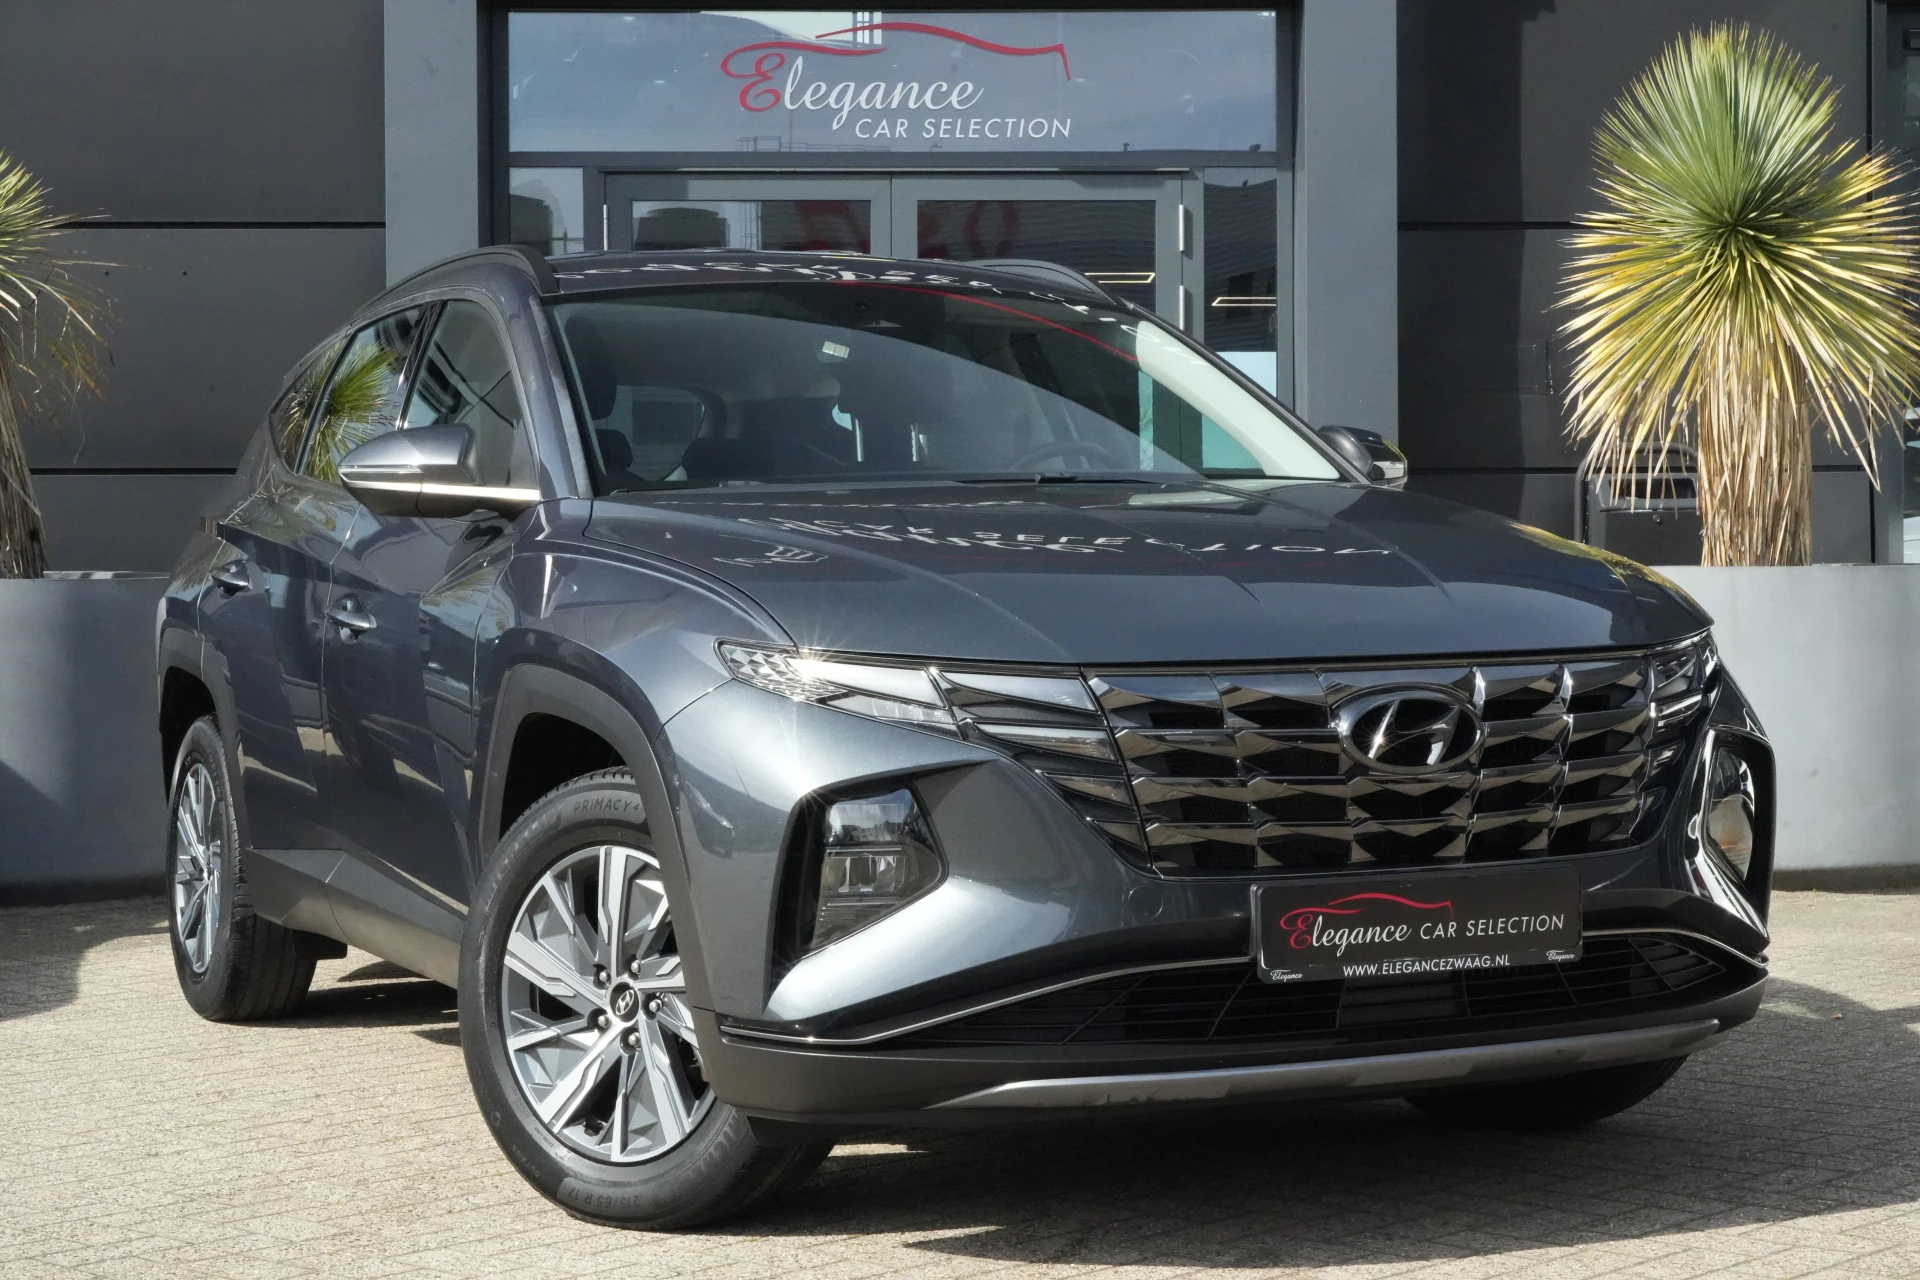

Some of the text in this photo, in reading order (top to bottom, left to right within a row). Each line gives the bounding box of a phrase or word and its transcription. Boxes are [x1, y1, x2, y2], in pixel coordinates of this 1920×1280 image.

[720, 42, 985, 131] Elegance
[855, 118, 1072, 139] CAR SELECTION
[573, 798, 633, 814] PRIMACY
[1280, 907, 1565, 957] Elegance CAR SELECTION
[1342, 954, 1511, 978] WWW.ELEGANCEZWAAG.NL
[567, 1187, 580, 1201] 17
[583, 1193, 594, 1206] R
